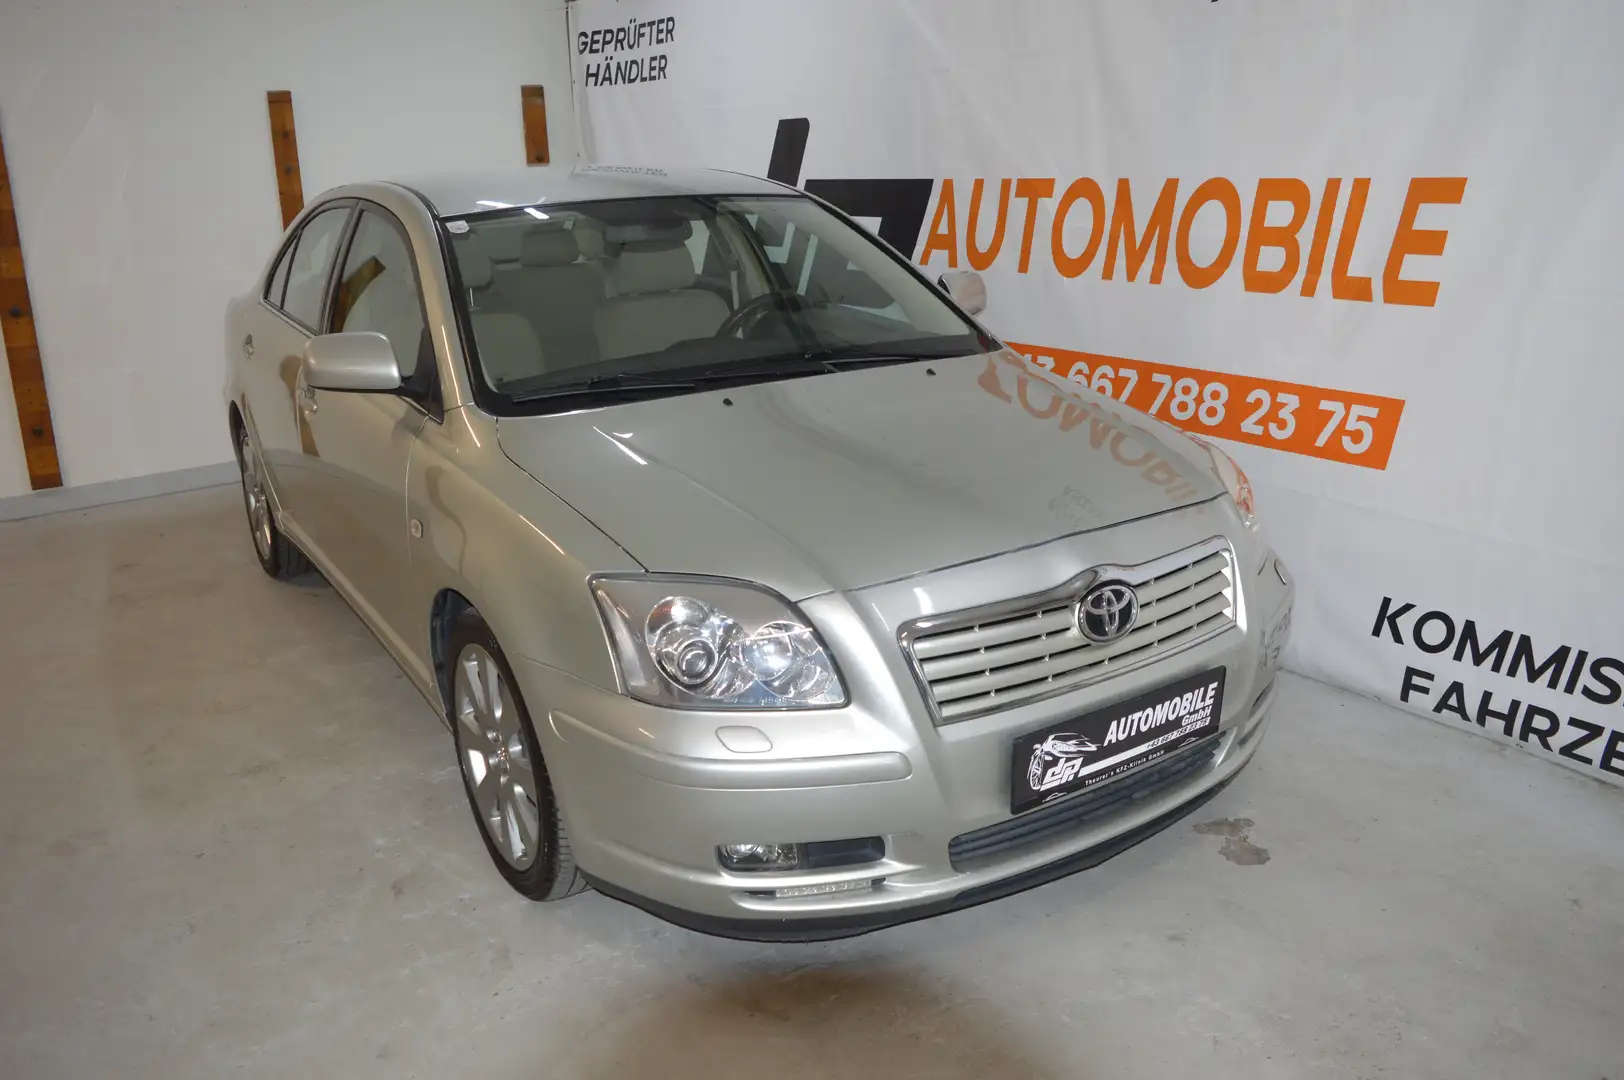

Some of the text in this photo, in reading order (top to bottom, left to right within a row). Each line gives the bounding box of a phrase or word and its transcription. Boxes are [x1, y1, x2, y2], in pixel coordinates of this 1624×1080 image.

[577, 16, 676, 56] GEPRÜFTER
[585, 54, 668, 88] HÄNDLER
[918, 176, 1469, 307] AUTOMOBILE
[1148, 372, 1229, 426] 788
[1240, 388, 1300, 440] 23
[1314, 400, 1380, 456] 75
[1103, 681, 1219, 747] AUTOMOBILE
[1181, 705, 1212, 727] GmbH
[1400, 665, 1624, 778] FAHRZE
